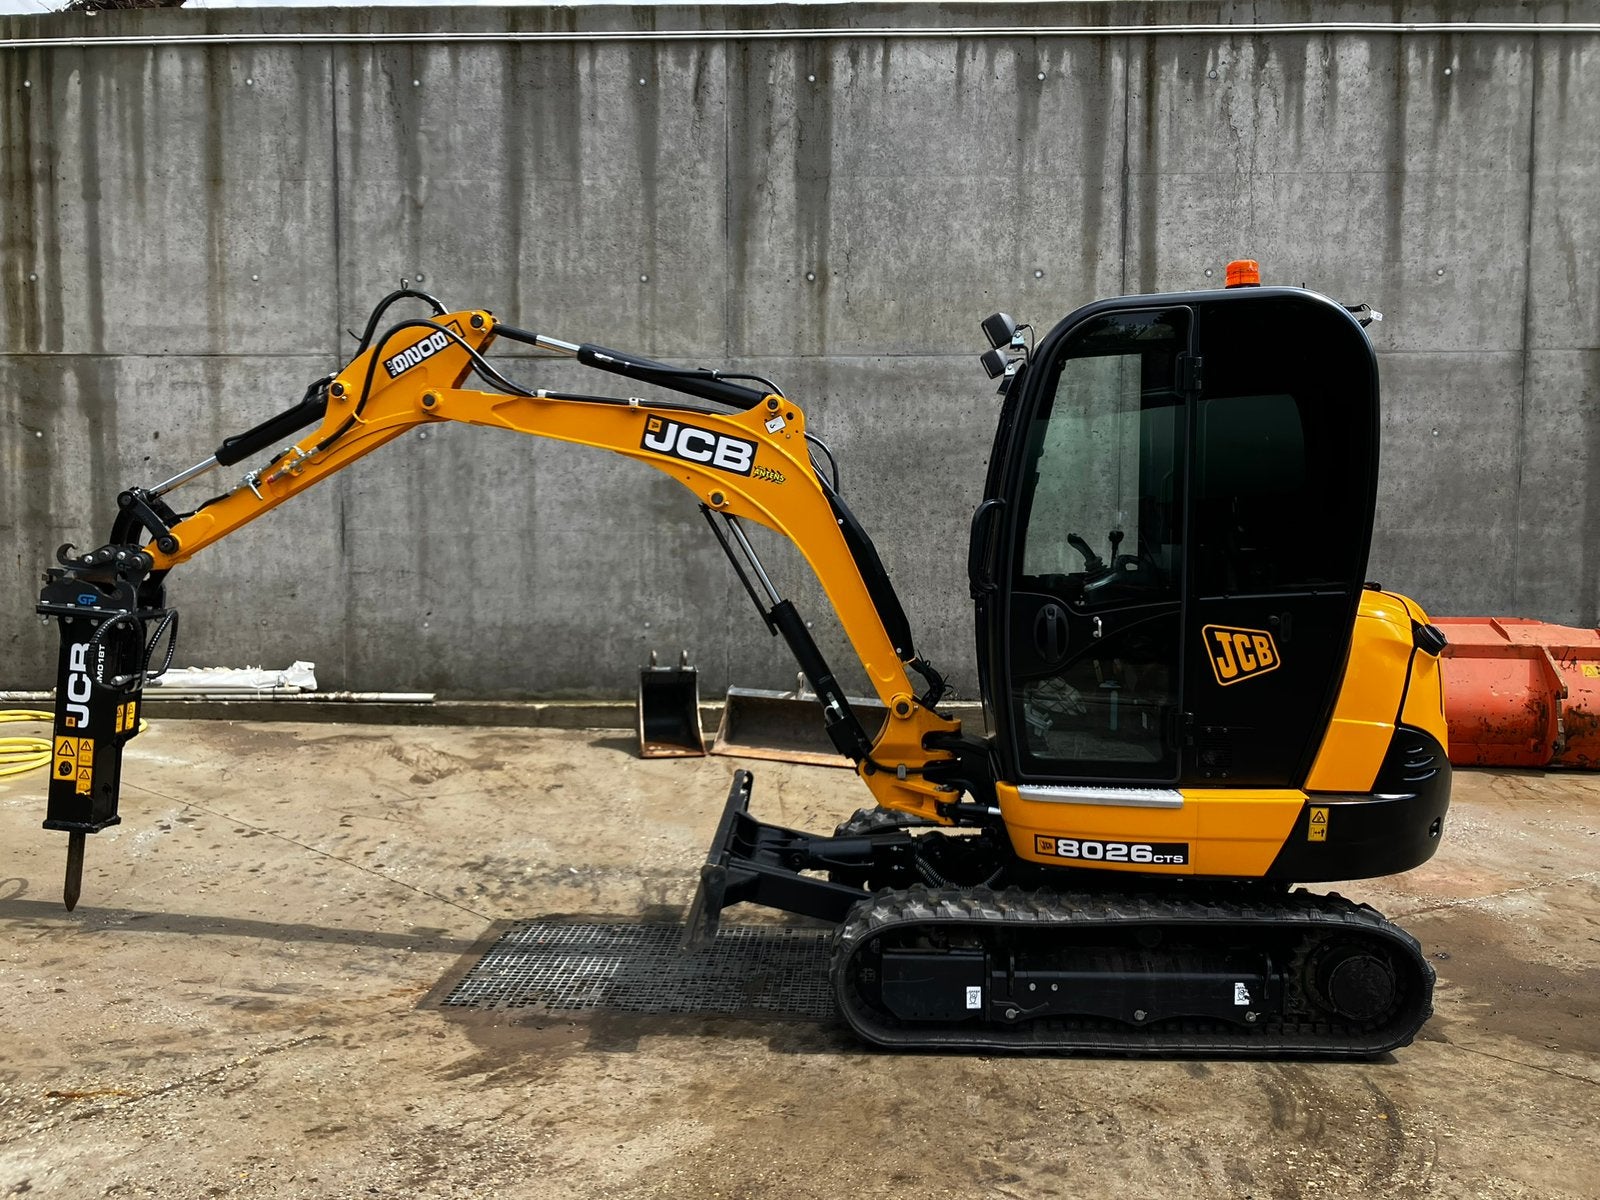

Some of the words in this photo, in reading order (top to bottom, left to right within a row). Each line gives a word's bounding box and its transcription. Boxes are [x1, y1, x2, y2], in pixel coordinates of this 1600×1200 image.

[392, 330, 449, 373] 8026
[644, 422, 753, 472] JCB
[1214, 631, 1274, 679] JCB
[1057, 839, 1153, 863] 8026
[1153, 855, 1184, 864] CTS
